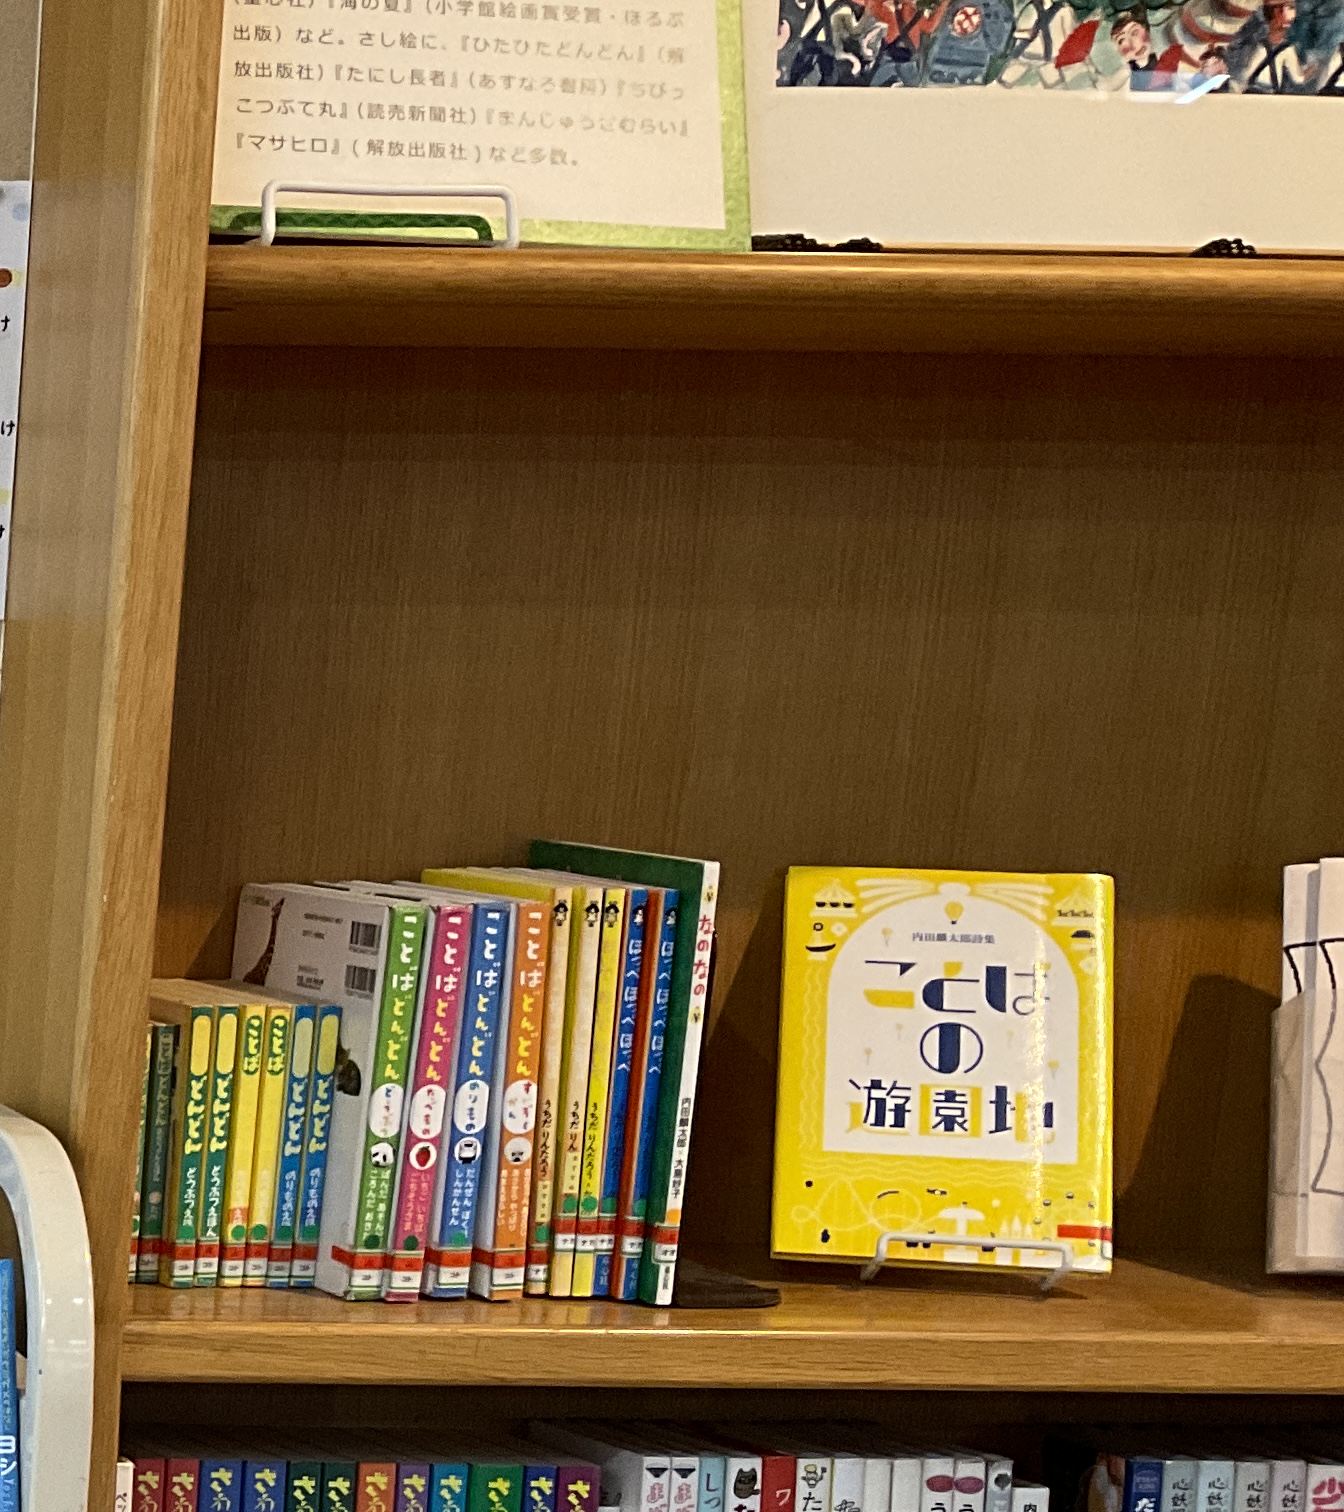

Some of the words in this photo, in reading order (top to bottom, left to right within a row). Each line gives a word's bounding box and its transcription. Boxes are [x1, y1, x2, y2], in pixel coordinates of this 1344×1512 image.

[693, 915, 714, 996] なのなの
[920, 1021, 983, 1075] の
[845, 1078, 1055, 1144] 遊園地
